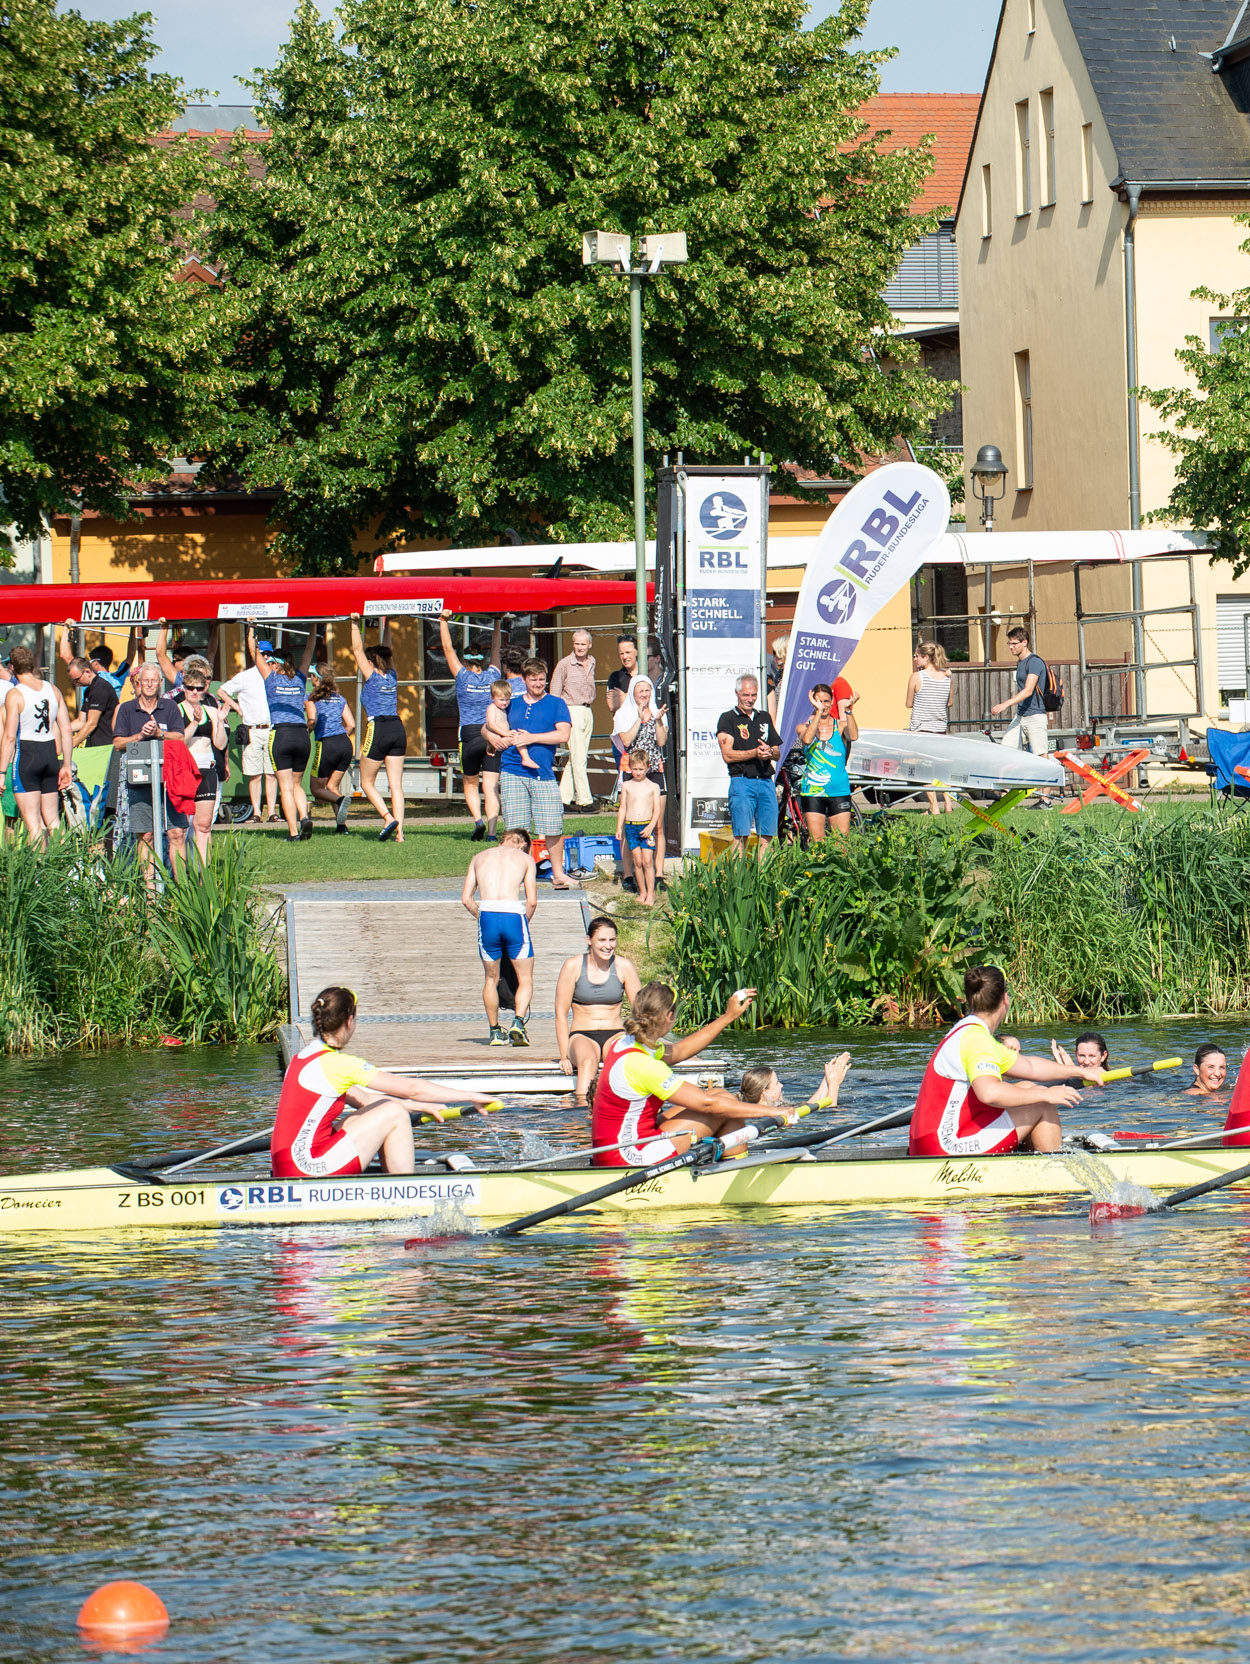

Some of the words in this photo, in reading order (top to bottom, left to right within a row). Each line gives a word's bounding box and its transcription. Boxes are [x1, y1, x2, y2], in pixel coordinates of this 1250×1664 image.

[838, 489, 923, 579] RBL
[864, 497, 930, 585] RUDER-BUNDESLIGA
[699, 551, 748, 569] RBL
[417, 602, 433, 612] RBL
[691, 597, 730, 608] STARK.
[83, 600, 146, 621] WURZEN
[691, 609, 743, 619] SCHNELL.
[691, 620, 718, 631] GUT.
[800, 636, 831, 649] STARK.
[797, 648, 841, 662] SCHNELL.
[725, 667, 755, 676] AUDIT
[795, 660, 816, 672] GUT.
[970, 805, 991, 822] Havel
[930, 1159, 985, 1185] Melitta
[118, 1193, 131, 1208] Z
[137, 1192, 164, 1207] BS
[171, 1190, 206, 1206] 001
[248, 1185, 302, 1204] RBL
[309, 1184, 475, 1202] RUDER-BUNDESLIGA
